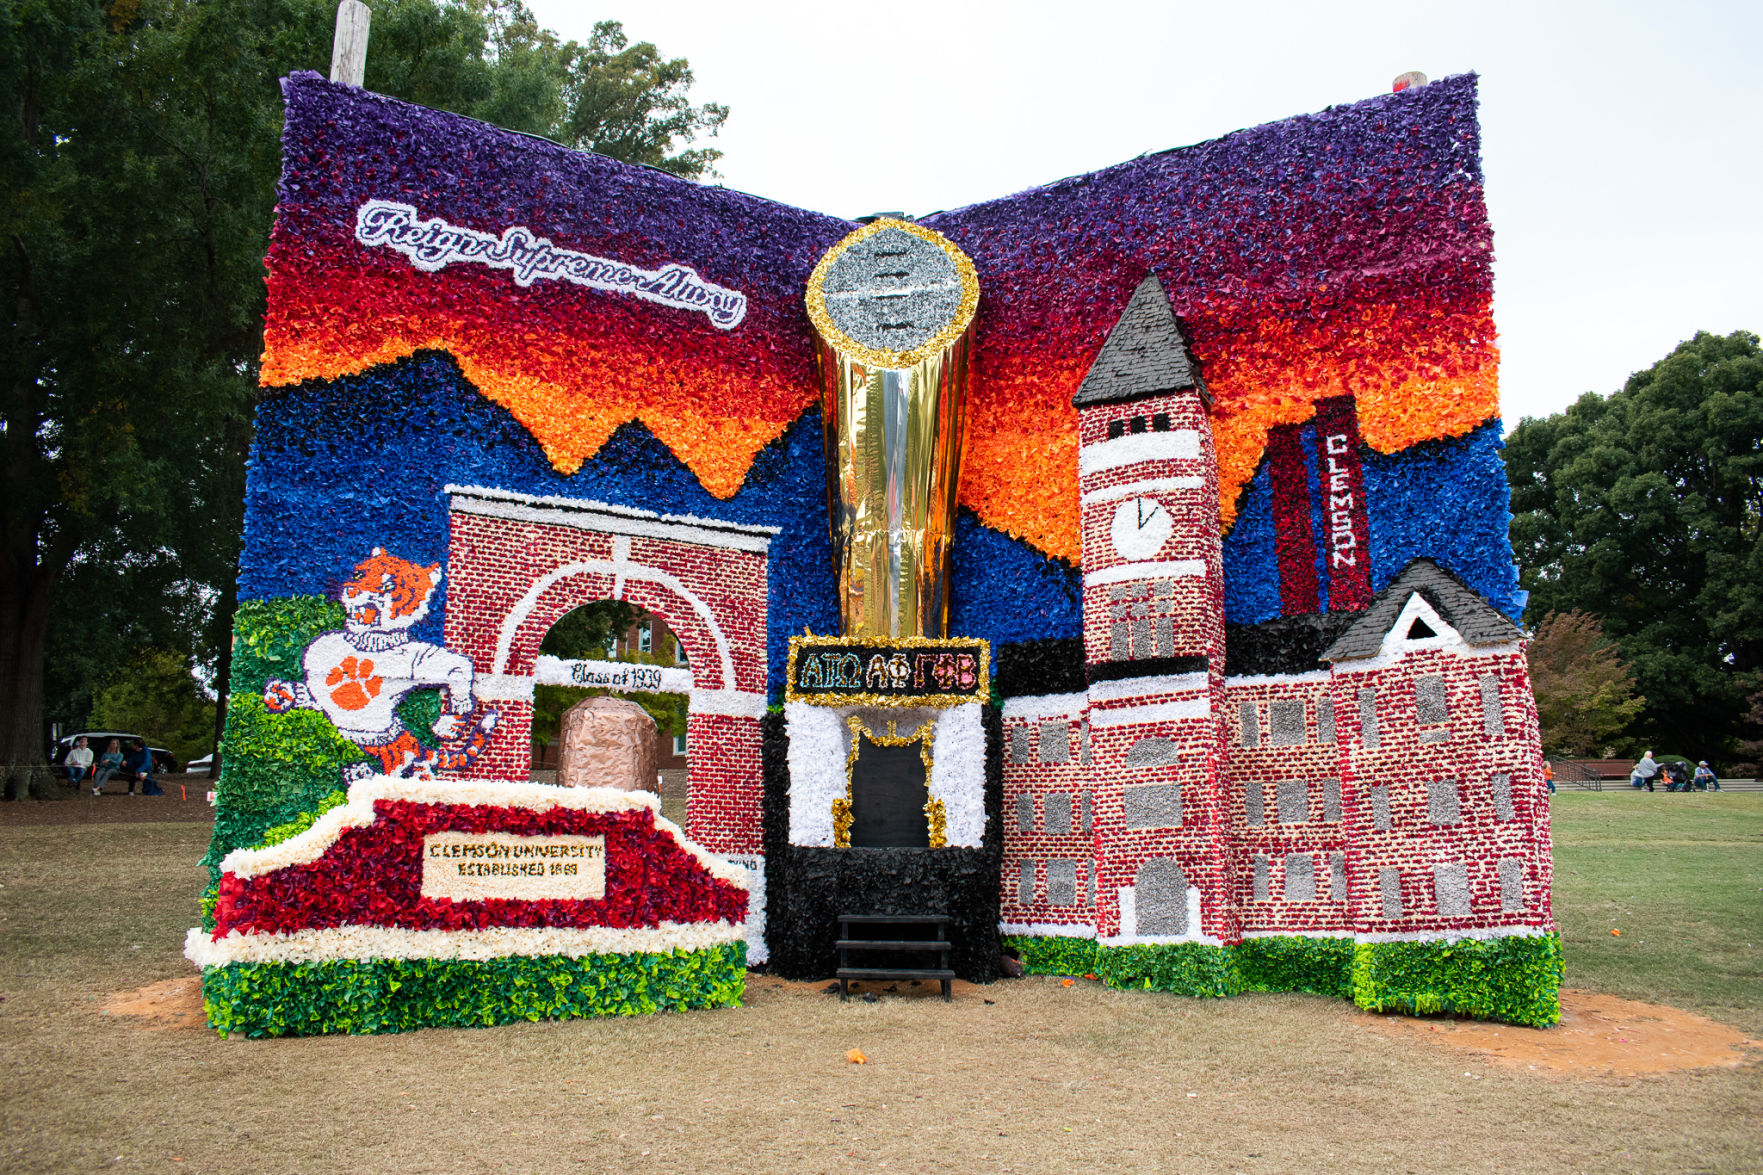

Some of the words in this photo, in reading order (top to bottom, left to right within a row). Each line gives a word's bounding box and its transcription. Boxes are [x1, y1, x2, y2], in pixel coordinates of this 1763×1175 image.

[361, 206, 479, 262] Reign
[480, 230, 638, 284] Supreme
[637, 267, 744, 323] Alway
[1326, 433, 1356, 569] CLEMSON
[571, 662, 610, 684] Class
[613, 668, 629, 685] of
[631, 667, 661, 689] 1939
[430, 843, 509, 859] CLEMSON
[513, 844, 603, 858] UNIVERSITY
[458, 863, 545, 876] ESTABLISHED
